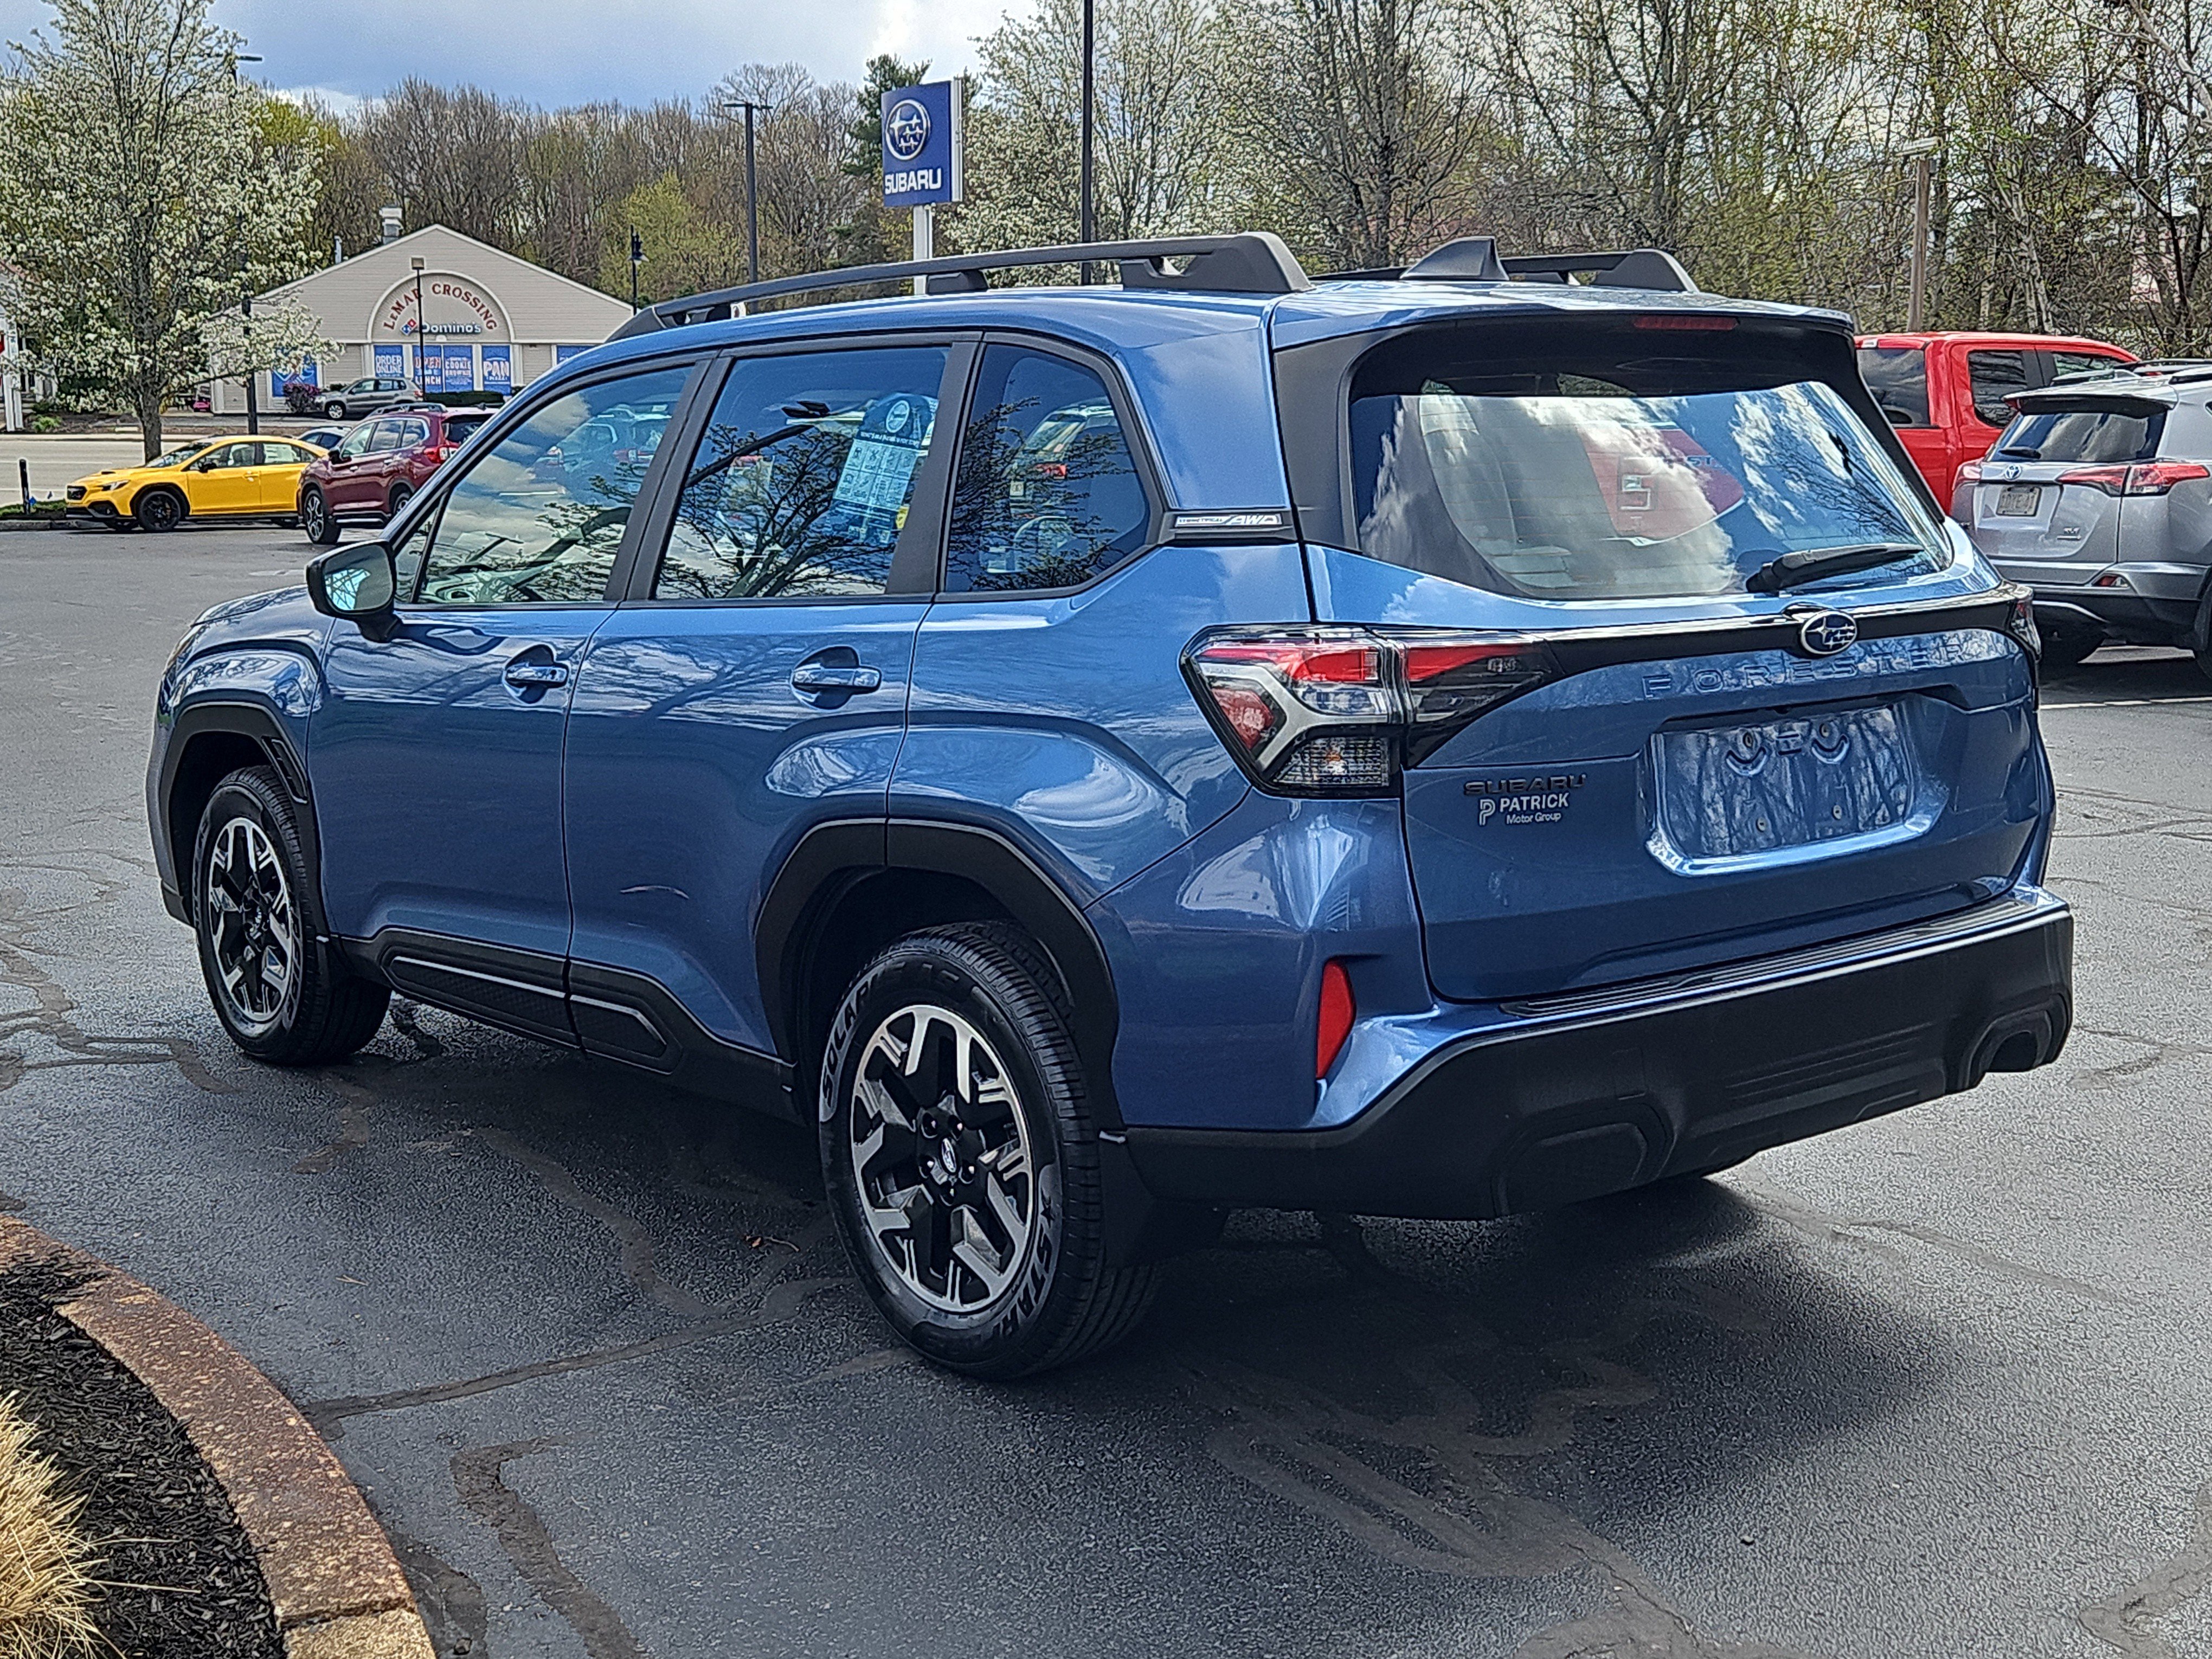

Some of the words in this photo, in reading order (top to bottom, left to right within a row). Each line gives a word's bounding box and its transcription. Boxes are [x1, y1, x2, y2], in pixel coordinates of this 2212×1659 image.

[885, 168, 942, 195] SUBARU
[432, 283, 497, 330] CROSSING
[420, 321, 481, 333] Domino's
[375, 355, 402, 365] ORDER
[415, 357, 441, 369] OPEN
[375, 364, 402, 374] ONLINE
[483, 361, 510, 376] PAN
[1225, 513, 1282, 525] AWD
[1642, 643, 1966, 699] FORESTER
[1464, 774, 1587, 795] SUBARU
[1500, 793, 1570, 812] PATRICK
[1506, 814, 1533, 824] Motor
[1535, 812, 1561, 822] Group
